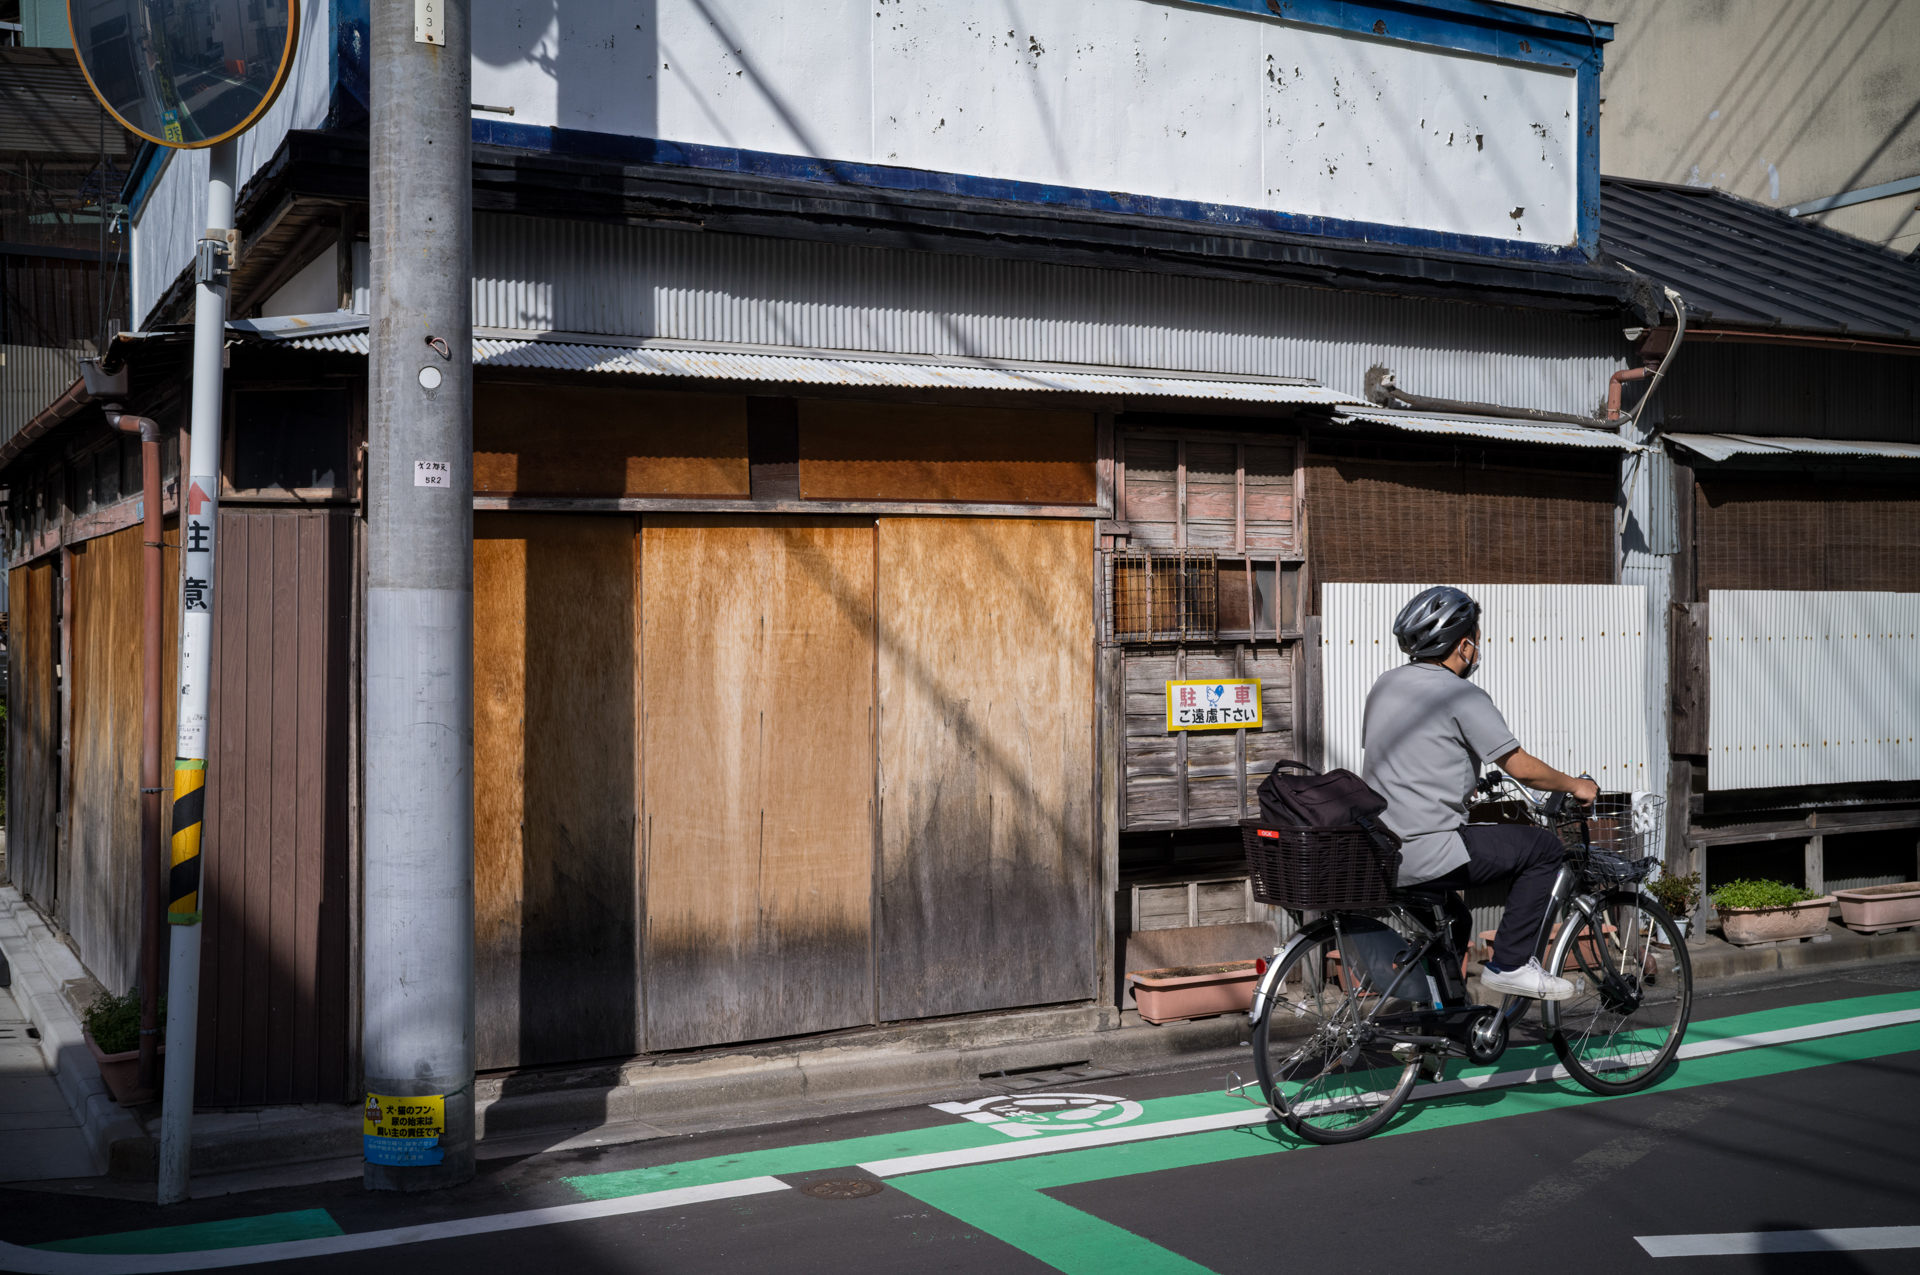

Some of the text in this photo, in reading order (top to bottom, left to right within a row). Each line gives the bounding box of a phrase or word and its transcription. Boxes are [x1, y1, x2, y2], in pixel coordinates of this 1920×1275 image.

[425, 2, 433, 27] 63
[425, 476, 442, 484] 5R2
[1179, 707, 1256, 724] ご遠慮下さい
[391, 1116, 434, 1127] 尿の始末は
[376, 1127, 442, 1138] 飼い主の責任です
